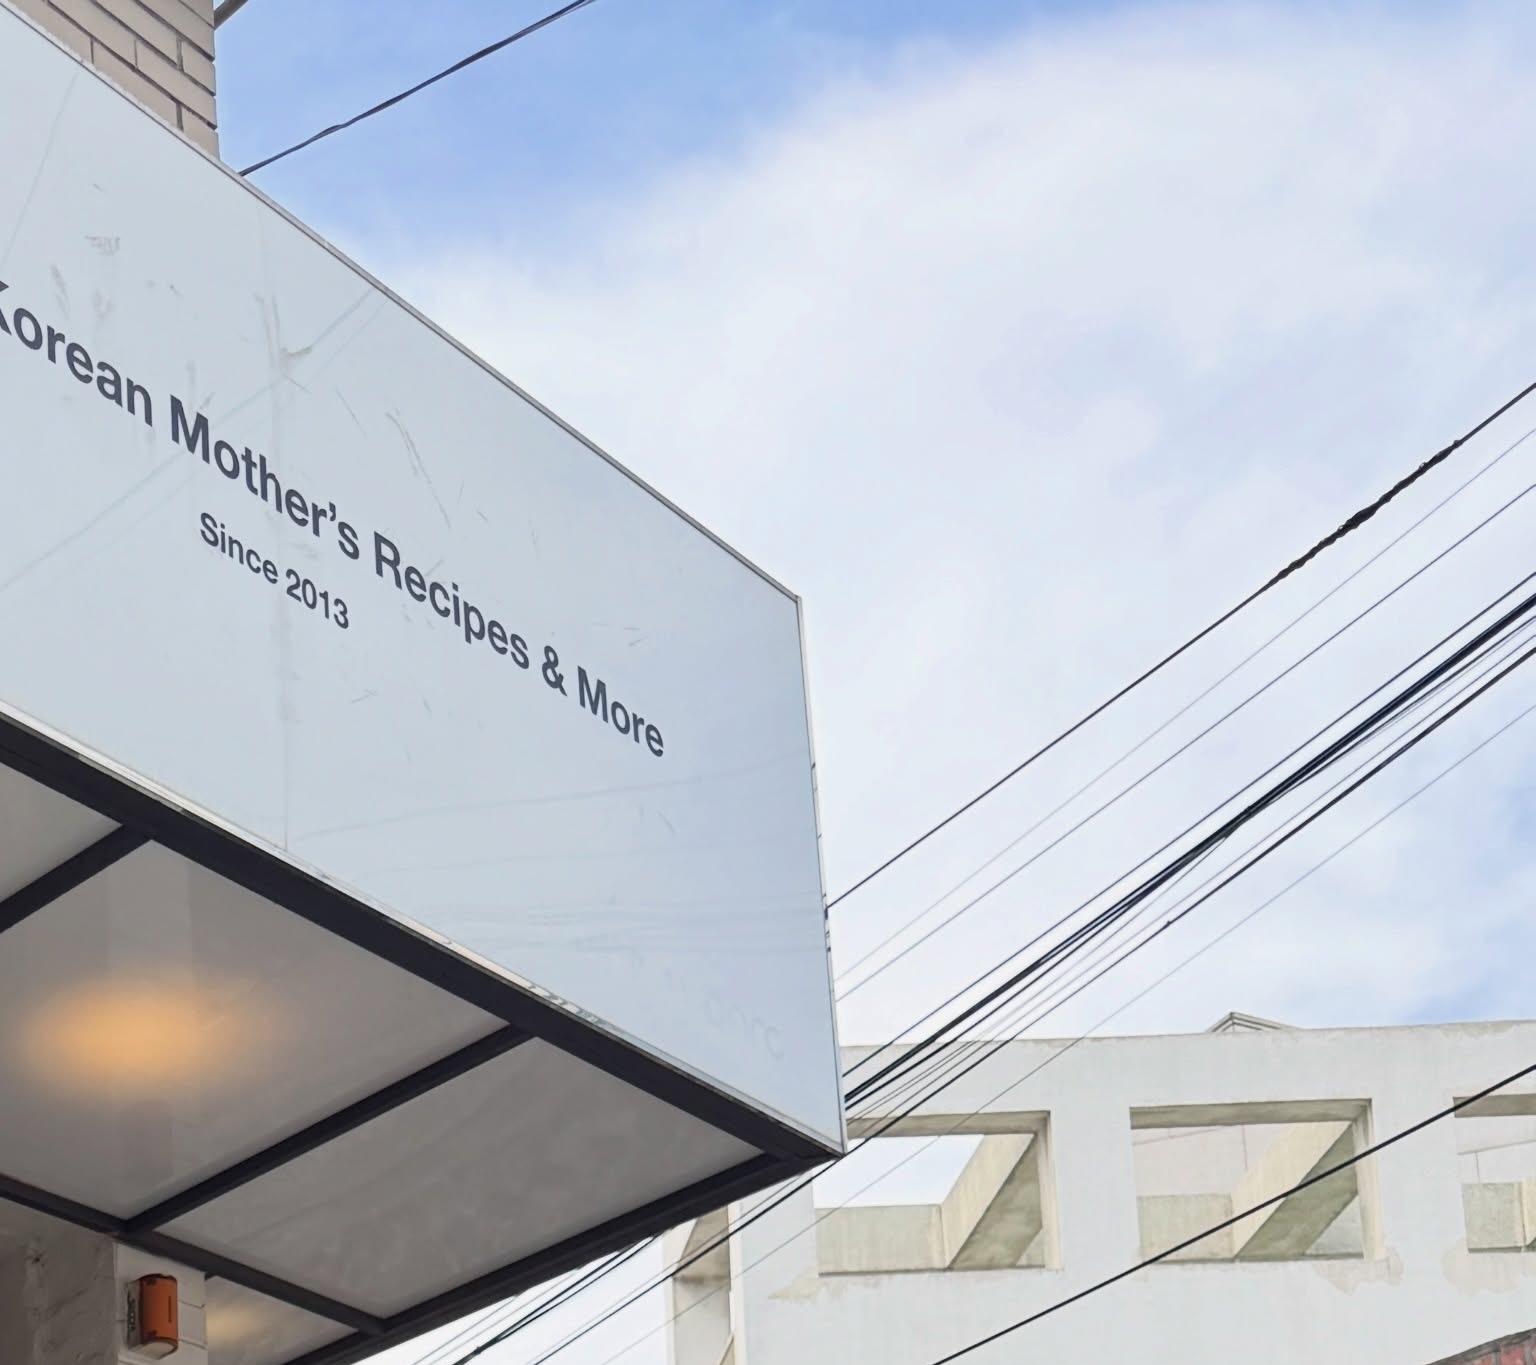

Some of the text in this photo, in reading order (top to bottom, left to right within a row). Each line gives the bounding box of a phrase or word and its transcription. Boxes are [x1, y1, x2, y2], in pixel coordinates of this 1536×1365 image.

[199, 512, 349, 629] Since 2013
[373, 531, 530, 670] Recipes
[541, 645, 568, 697] &
[577, 665, 664, 758] More
